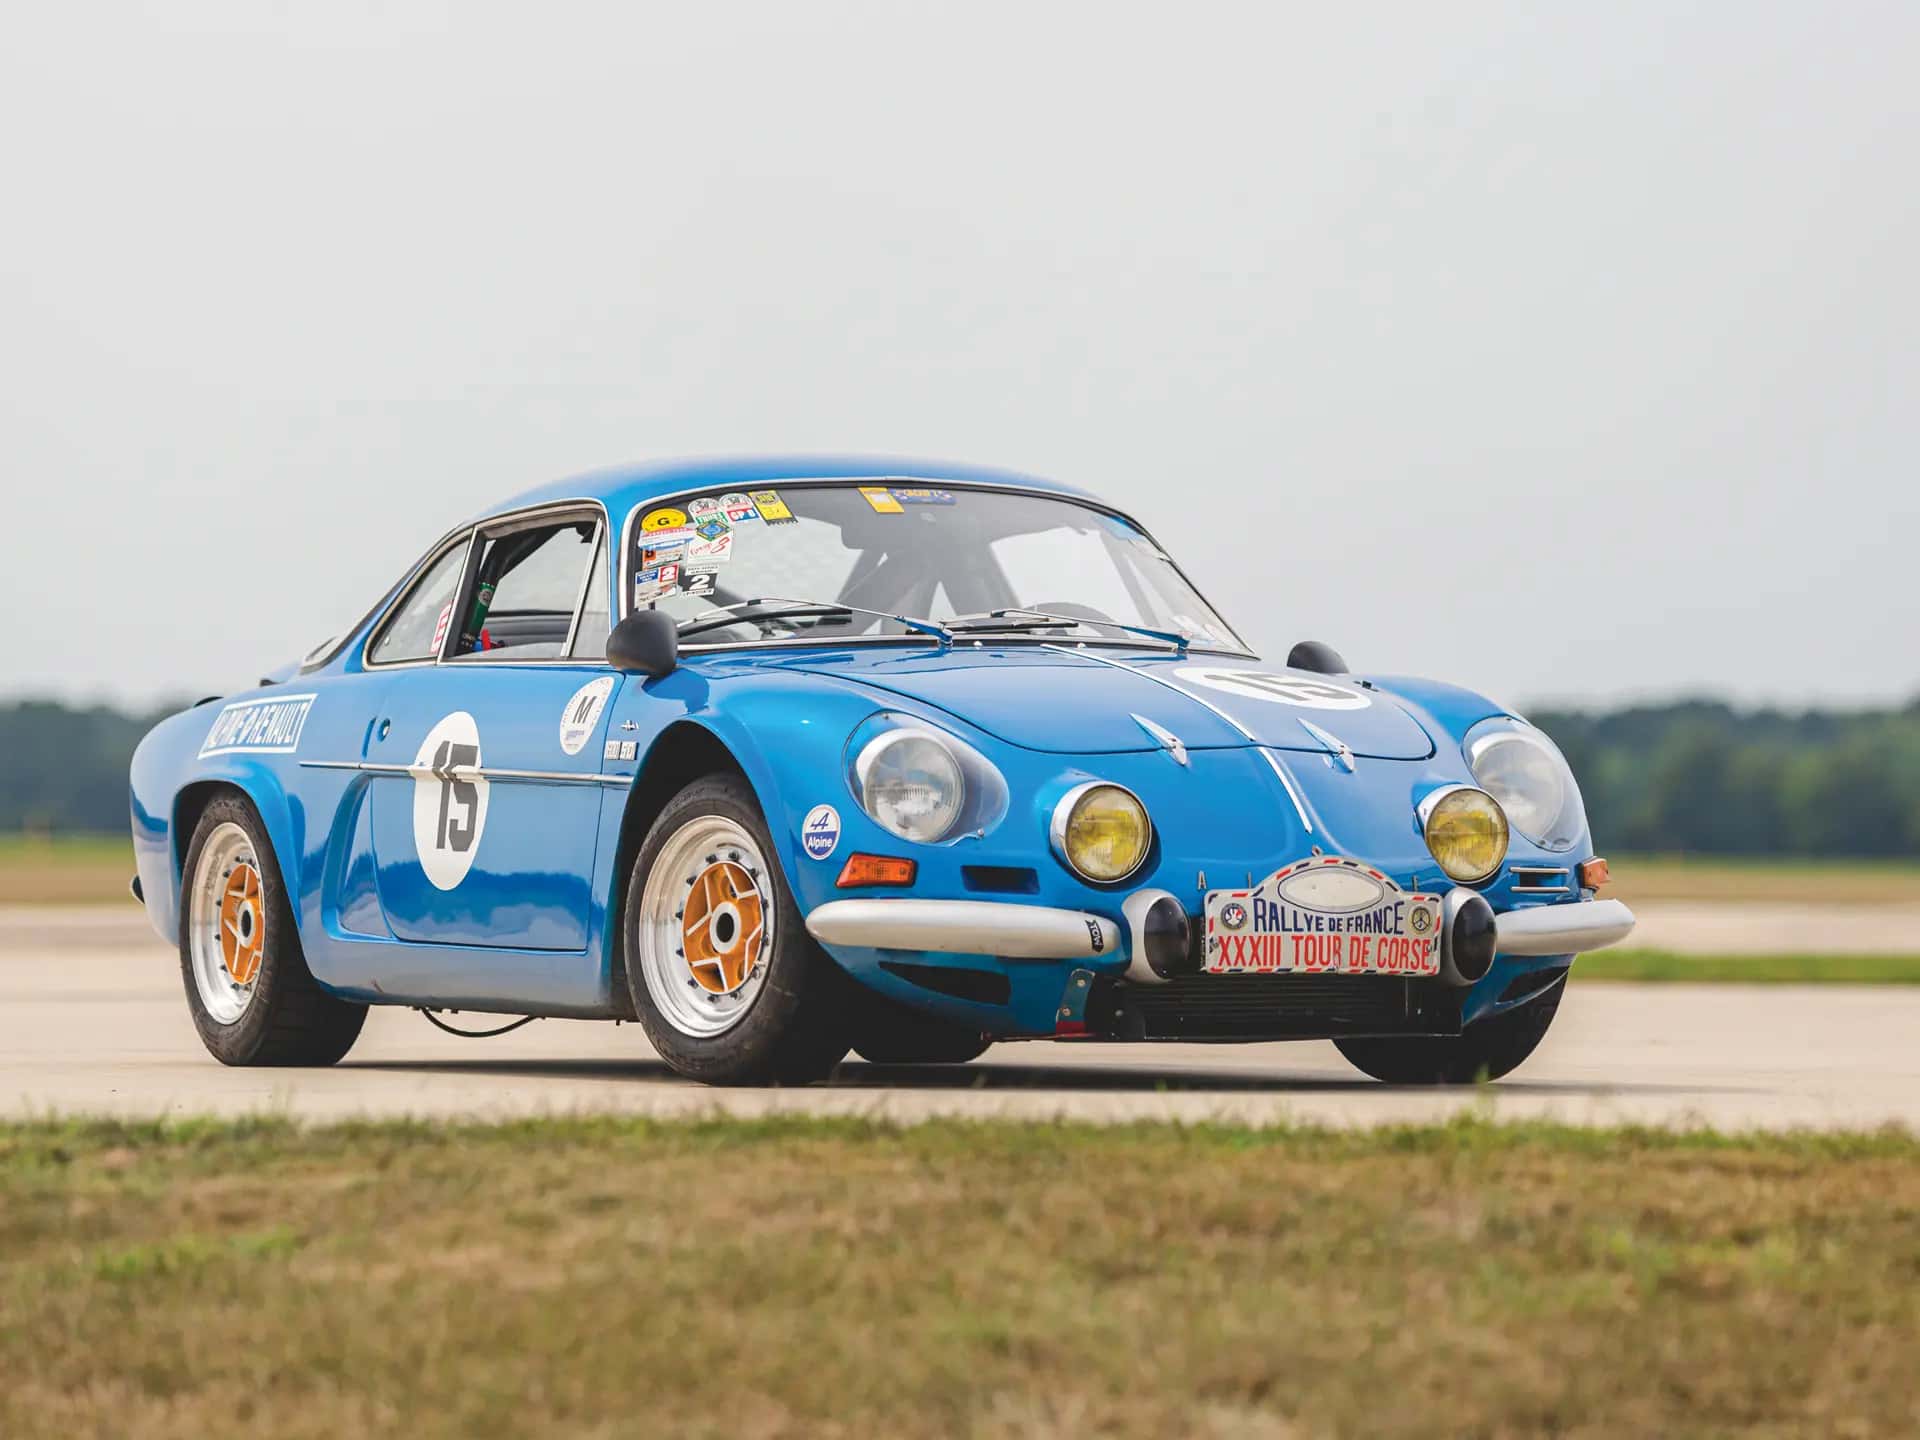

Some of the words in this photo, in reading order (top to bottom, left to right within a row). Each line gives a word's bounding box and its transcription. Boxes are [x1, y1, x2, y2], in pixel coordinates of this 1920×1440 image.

[689, 574, 711, 592] 2
[1204, 673, 1359, 701] 15
[572, 695, 597, 724] M
[432, 740, 479, 852] 15
[807, 834, 833, 850] Alpine
[1253, 898, 1324, 933] RALLYE
[1328, 916, 1343, 933] DE
[1347, 901, 1405, 935] FRANCE
[1089, 923, 1104, 946] TOW
[1218, 935, 1282, 968] XXXIII
[1291, 935, 1342, 969] TOUR
[1350, 936, 1375, 968] DE
[1377, 936, 1432, 970] CORSE
